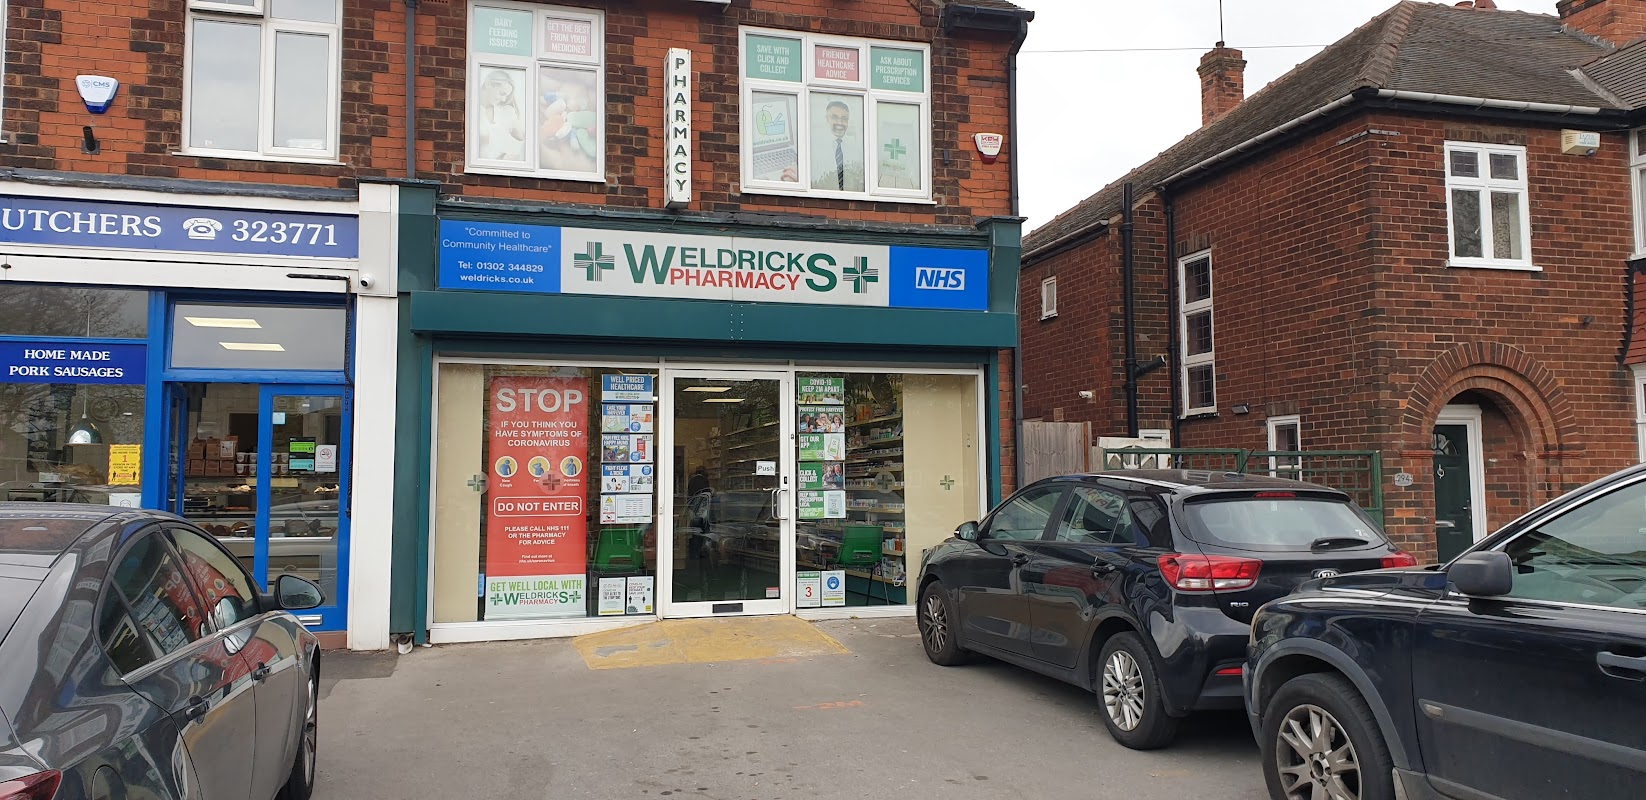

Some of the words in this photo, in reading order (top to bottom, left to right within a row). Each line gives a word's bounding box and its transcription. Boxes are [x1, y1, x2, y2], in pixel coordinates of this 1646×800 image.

[494, 18, 512, 26] BABY
[489, 28, 518, 38] FEEDING
[548, 23, 560, 31] GET
[561, 23, 573, 32] THE
[574, 25, 590, 34] BEST
[489, 38, 517, 48] ISSUES?
[551, 32, 568, 41] FROM
[571, 35, 586, 43] YOUR
[552, 43, 586, 53] MEDICINES
[757, 45, 772, 53] SAVE
[773, 47, 789, 55] WITH
[758, 54, 774, 63] CLICK
[777, 57, 789, 65] AND
[822, 50, 850, 59] FRIENDLY
[817, 59, 854, 70] HEALTHCARE
[880, 56, 892, 64] ASK
[893, 58, 912, 66] ABOUT
[760, 64, 786, 74] COLLECT
[826, 69, 847, 79] ADVICE
[876, 66, 917, 76] PRESCRIPTION
[883, 76, 910, 85] SERVICES
[674, 58, 687, 191] PHARMACY
[2, 208, 162, 237] UTCHERS
[231, 220, 337, 246] 323771
[465, 228, 519, 239] "Committed
[521, 231, 530, 239] to
[442, 239, 495, 252] Community
[499, 242, 552, 253] Healthcare"
[458, 261, 473, 269] Tel:
[476, 262, 504, 270] 01302
[508, 263, 543, 272] 344829
[460, 274, 534, 284] weldricks.co.uk
[670, 268, 800, 290] PHARMACY
[917, 269, 962, 288] NHS
[25, 349, 65, 360] HOME
[70, 351, 110, 361] MADE
[9, 366, 49, 376] PORK
[54, 367, 123, 377] SAUSAGES
[496, 388, 582, 412] STOP
[508, 439, 570, 447] CORONAVIRUS
[498, 503, 514, 511] DO
[517, 503, 540, 511] NOT
[543, 502, 578, 511] ENTER
[491, 582, 506, 591] GET
[508, 582, 530, 591] WELL
[534, 581, 558, 590] LOCAL
[561, 580, 581, 590] WITH
[805, 586, 812, 597] 3
